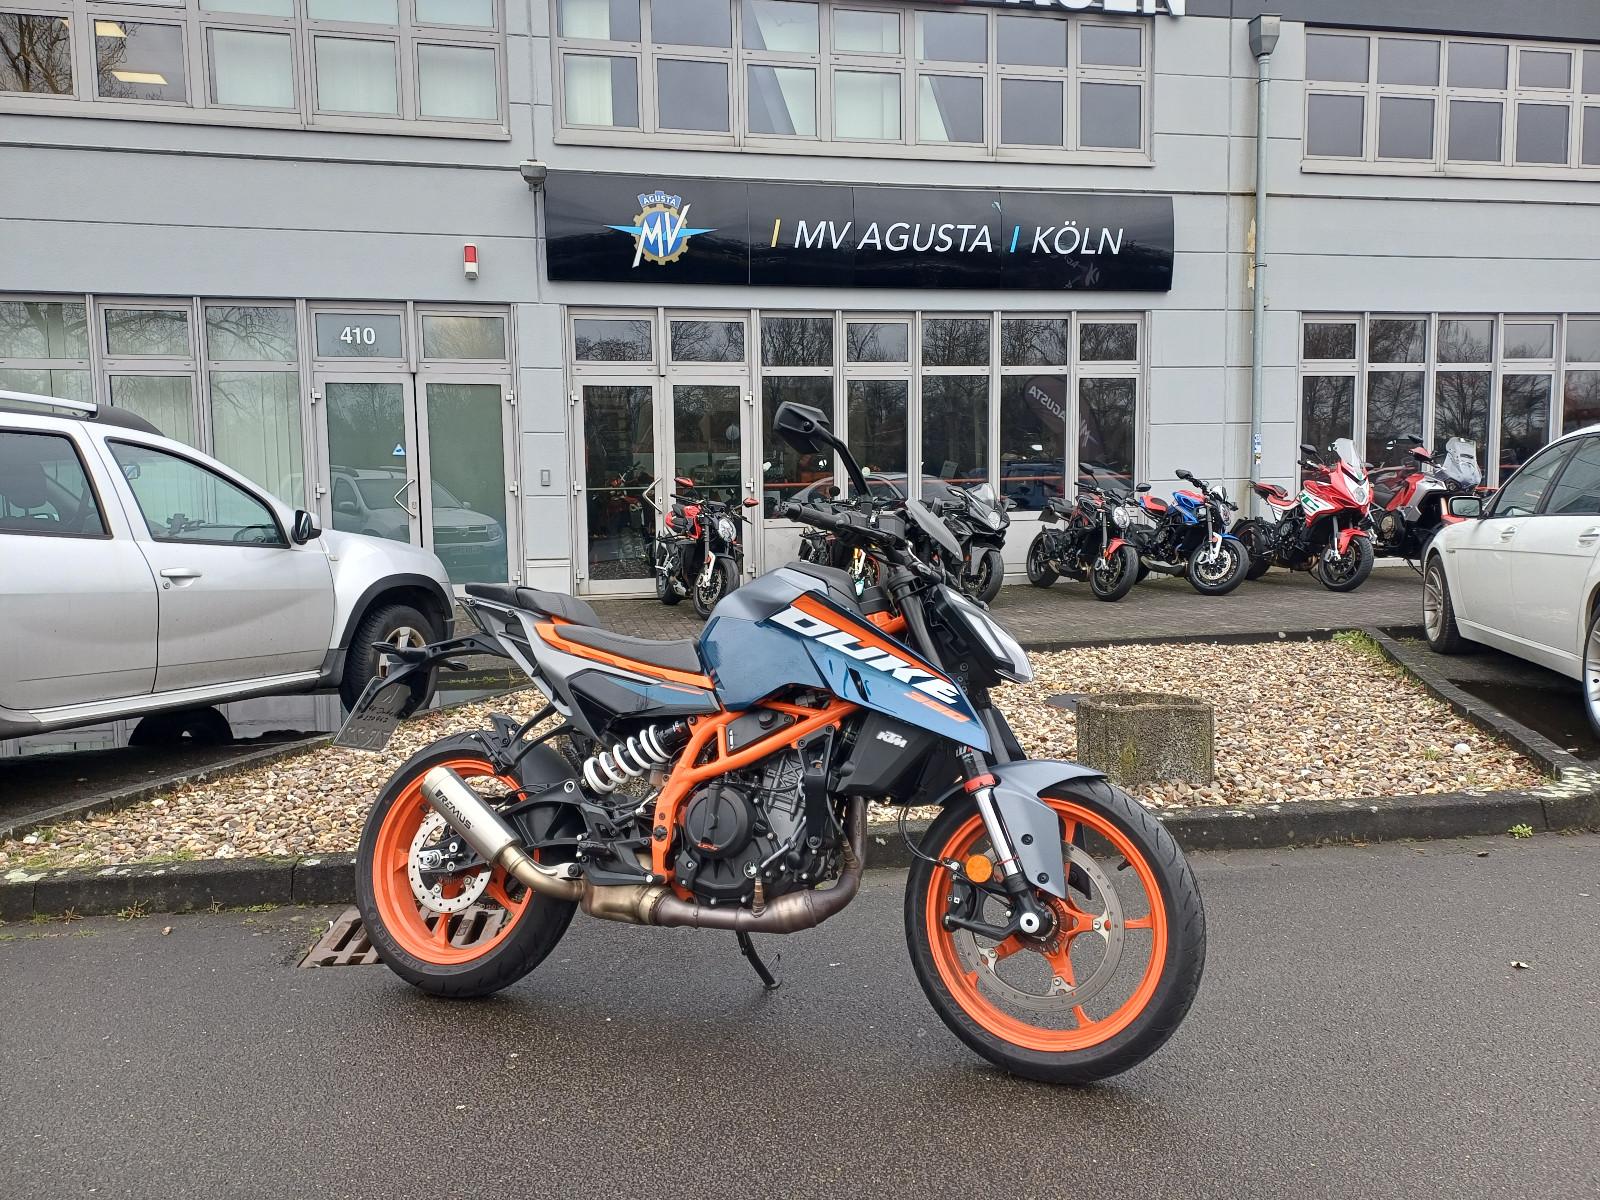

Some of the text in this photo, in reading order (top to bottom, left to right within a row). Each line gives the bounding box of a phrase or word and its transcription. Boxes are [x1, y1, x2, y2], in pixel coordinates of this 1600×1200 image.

[643, 194, 677, 206] AGUSTA
[631, 203, 692, 268] MV
[794, 220, 1124, 255] MV AGUSTA KÖLN
[340, 326, 376, 345] 410
[768, 605, 961, 705] DUKE
[876, 730, 908, 748] KTM
[438, 793, 473, 830] REMUS
